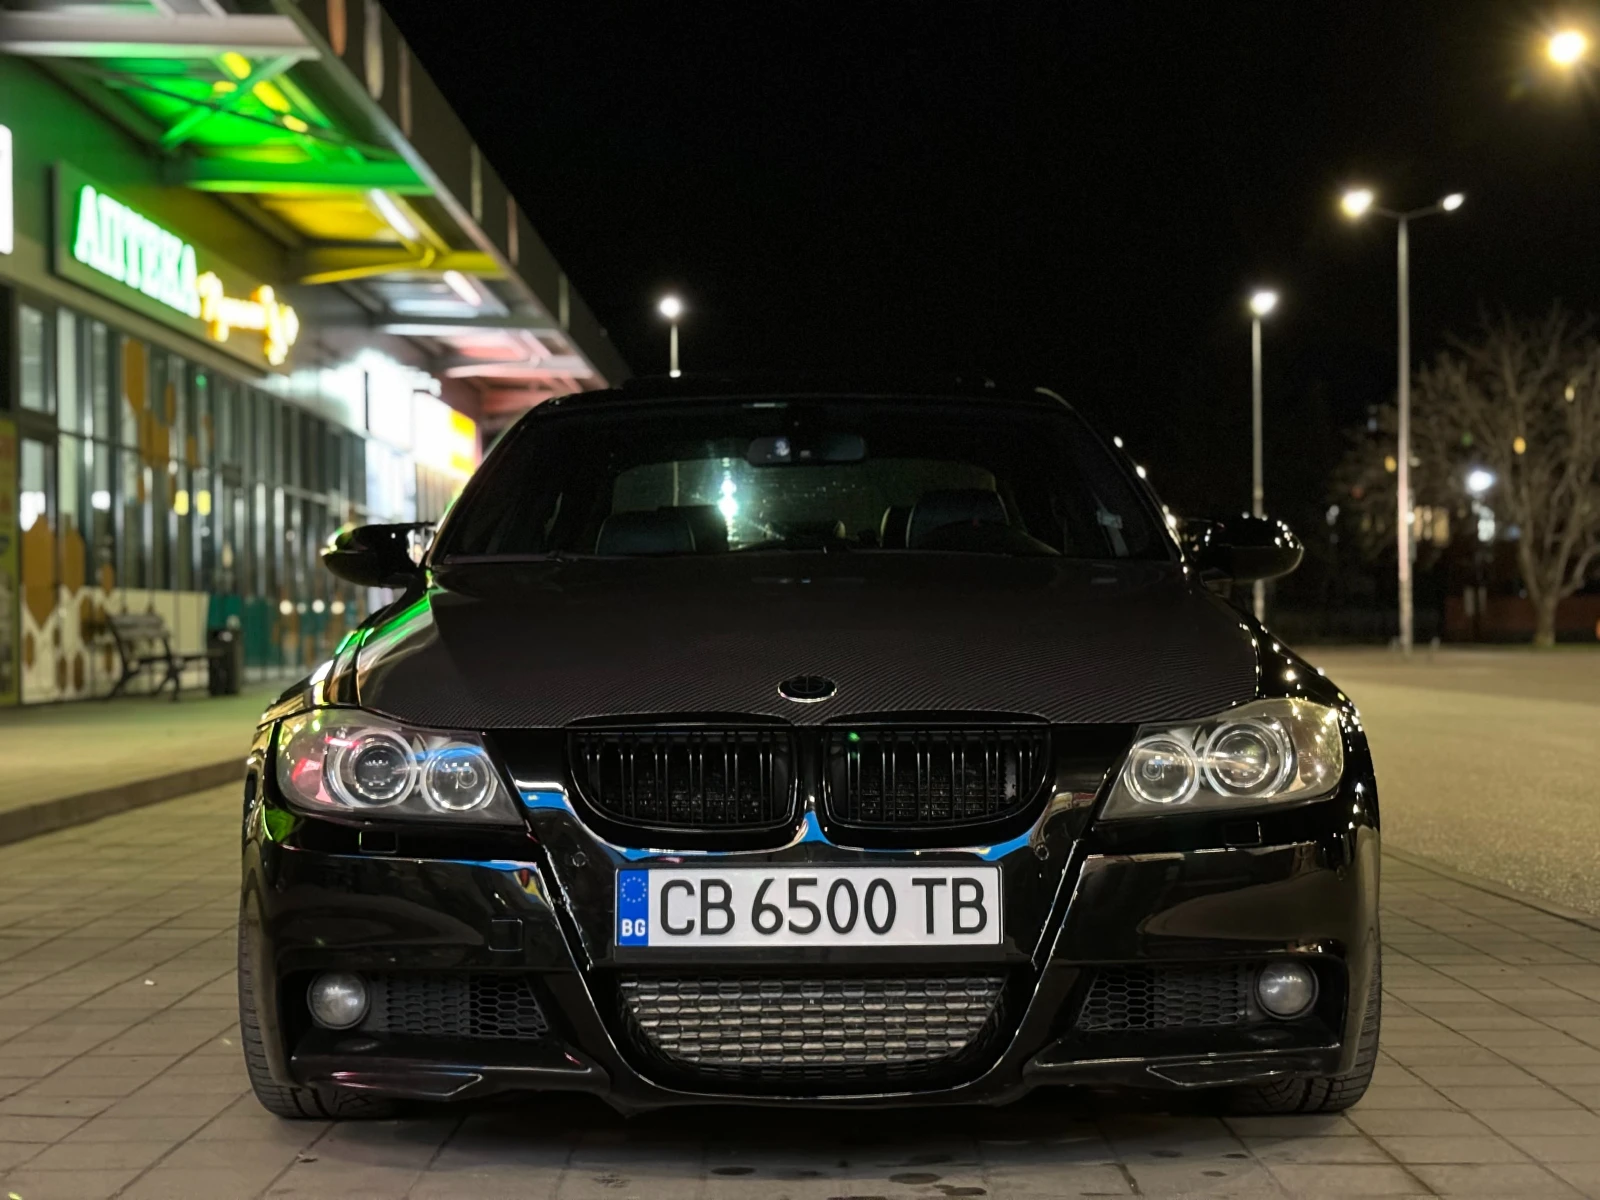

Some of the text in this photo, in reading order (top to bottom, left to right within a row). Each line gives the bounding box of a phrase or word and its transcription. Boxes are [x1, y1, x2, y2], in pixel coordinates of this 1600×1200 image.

[74, 184, 201, 319] АПТЕКА
[621, 918, 646, 937] BG
[660, 877, 989, 936] CB 6500 TB
